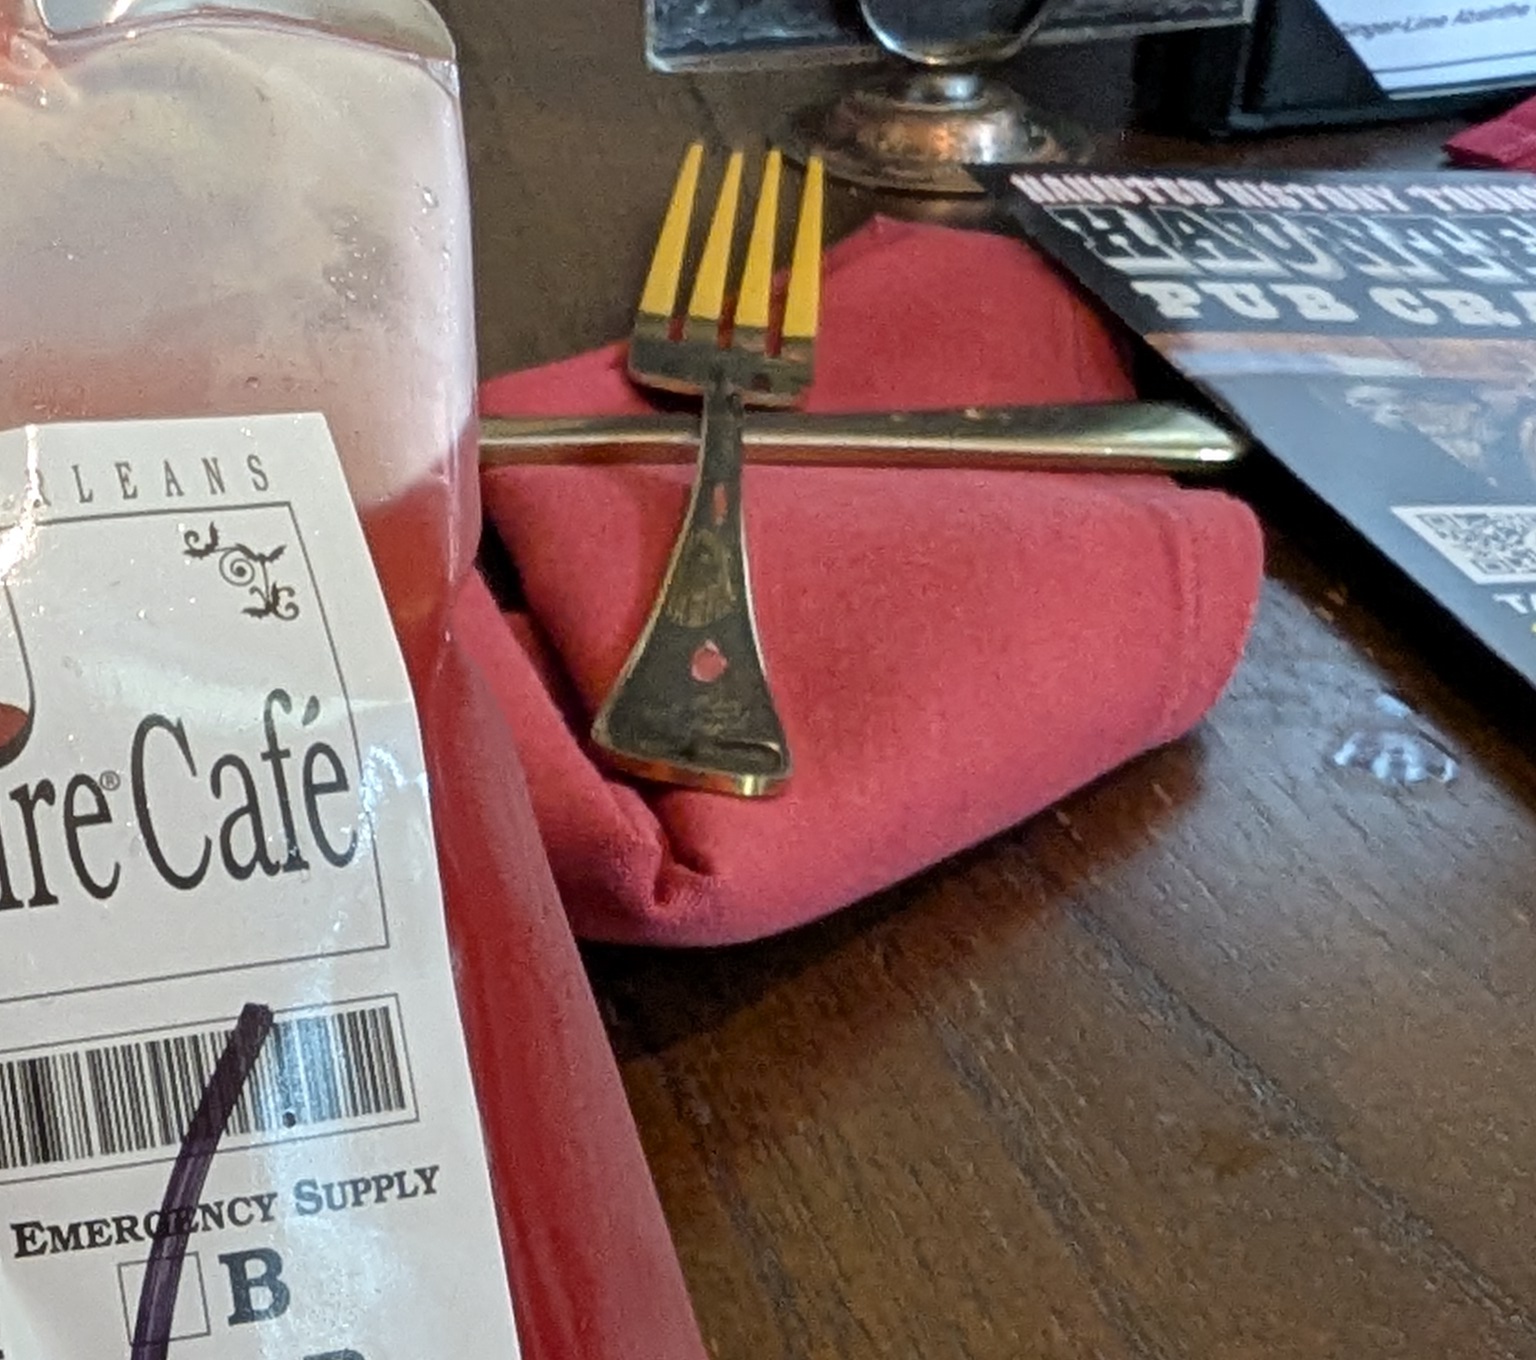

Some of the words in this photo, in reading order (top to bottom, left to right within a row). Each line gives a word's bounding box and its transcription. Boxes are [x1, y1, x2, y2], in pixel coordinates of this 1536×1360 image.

[1011, 174, 1224, 206] HAUNTED
[1215, 179, 1410, 213] HISTORY
[1129, 279, 1360, 324] PUB
[130, 687, 359, 890] Café
[292, 1165, 440, 1216] SUPPLY
[219, 1245, 292, 1327] B
